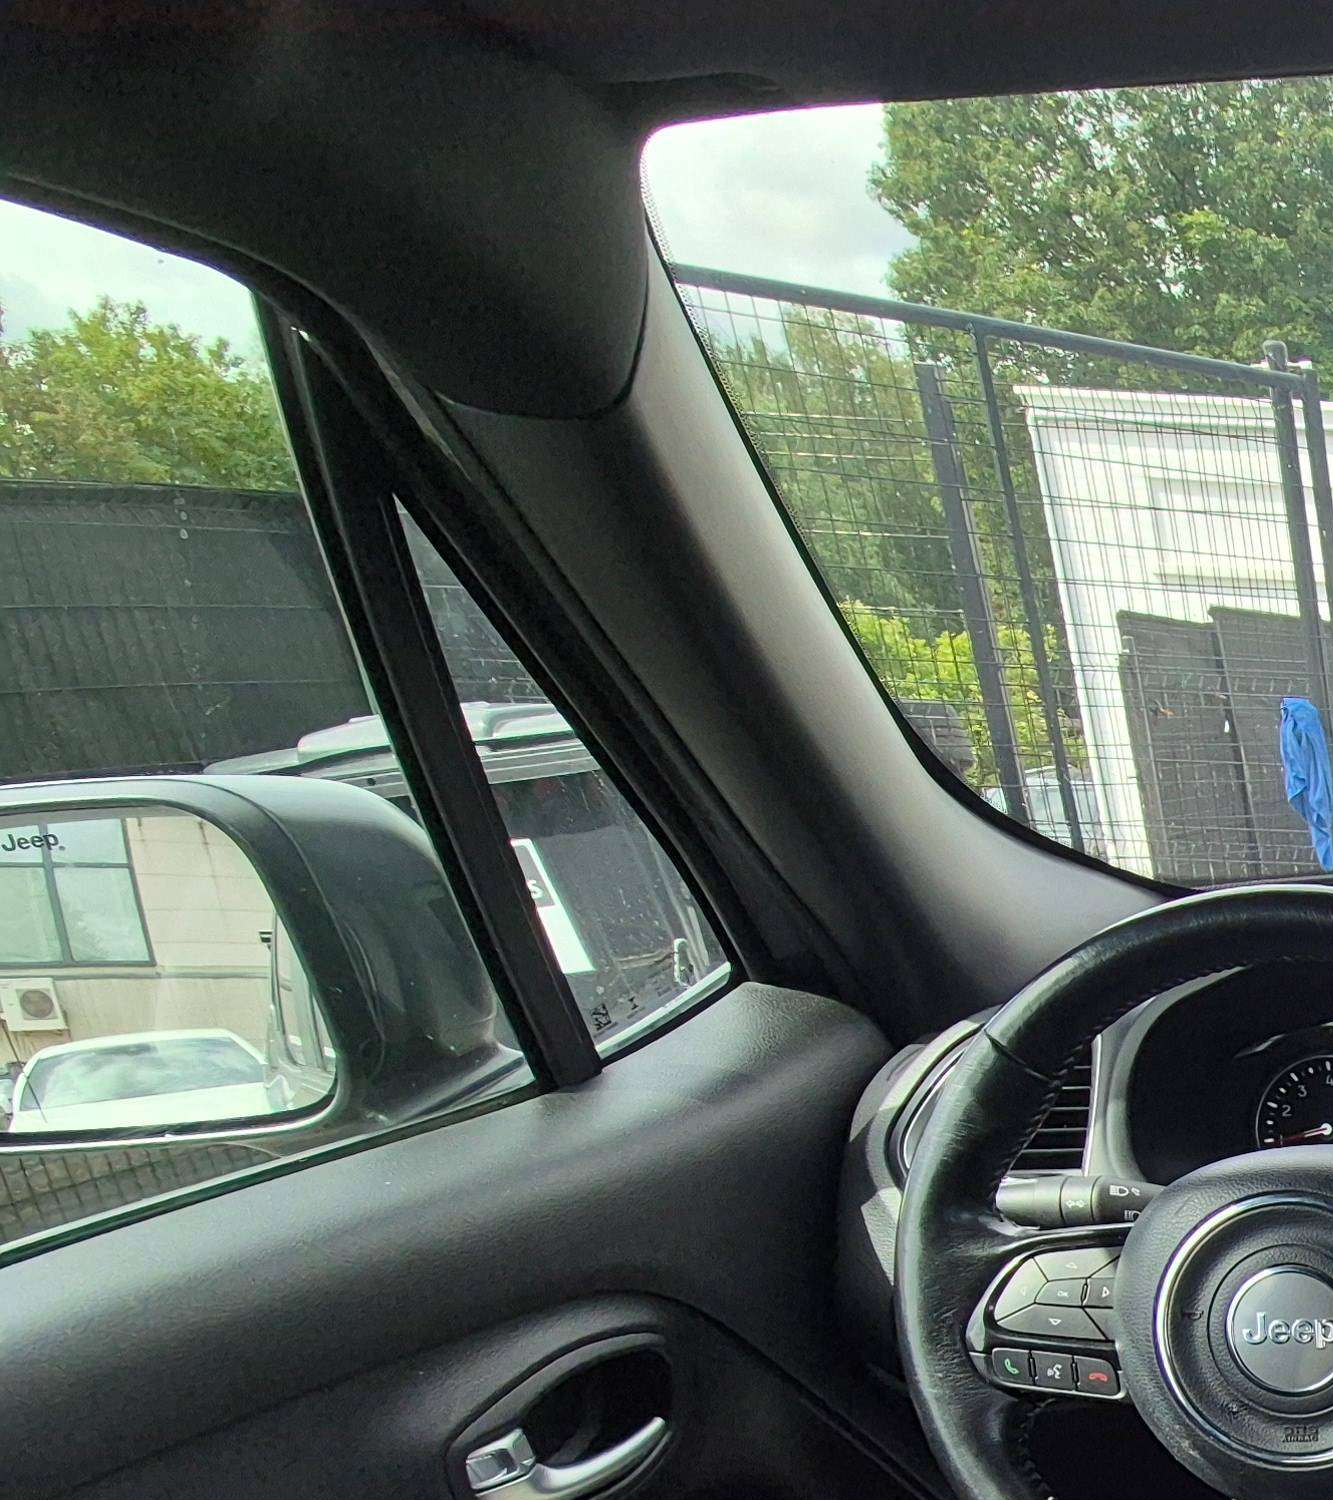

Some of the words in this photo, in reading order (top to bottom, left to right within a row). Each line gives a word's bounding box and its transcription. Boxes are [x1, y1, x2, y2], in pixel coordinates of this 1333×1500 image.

[1, 833, 59, 851] Jeep
[1298, 1085, 1307, 1097] 3
[1282, 1104, 1292, 1117] 2
